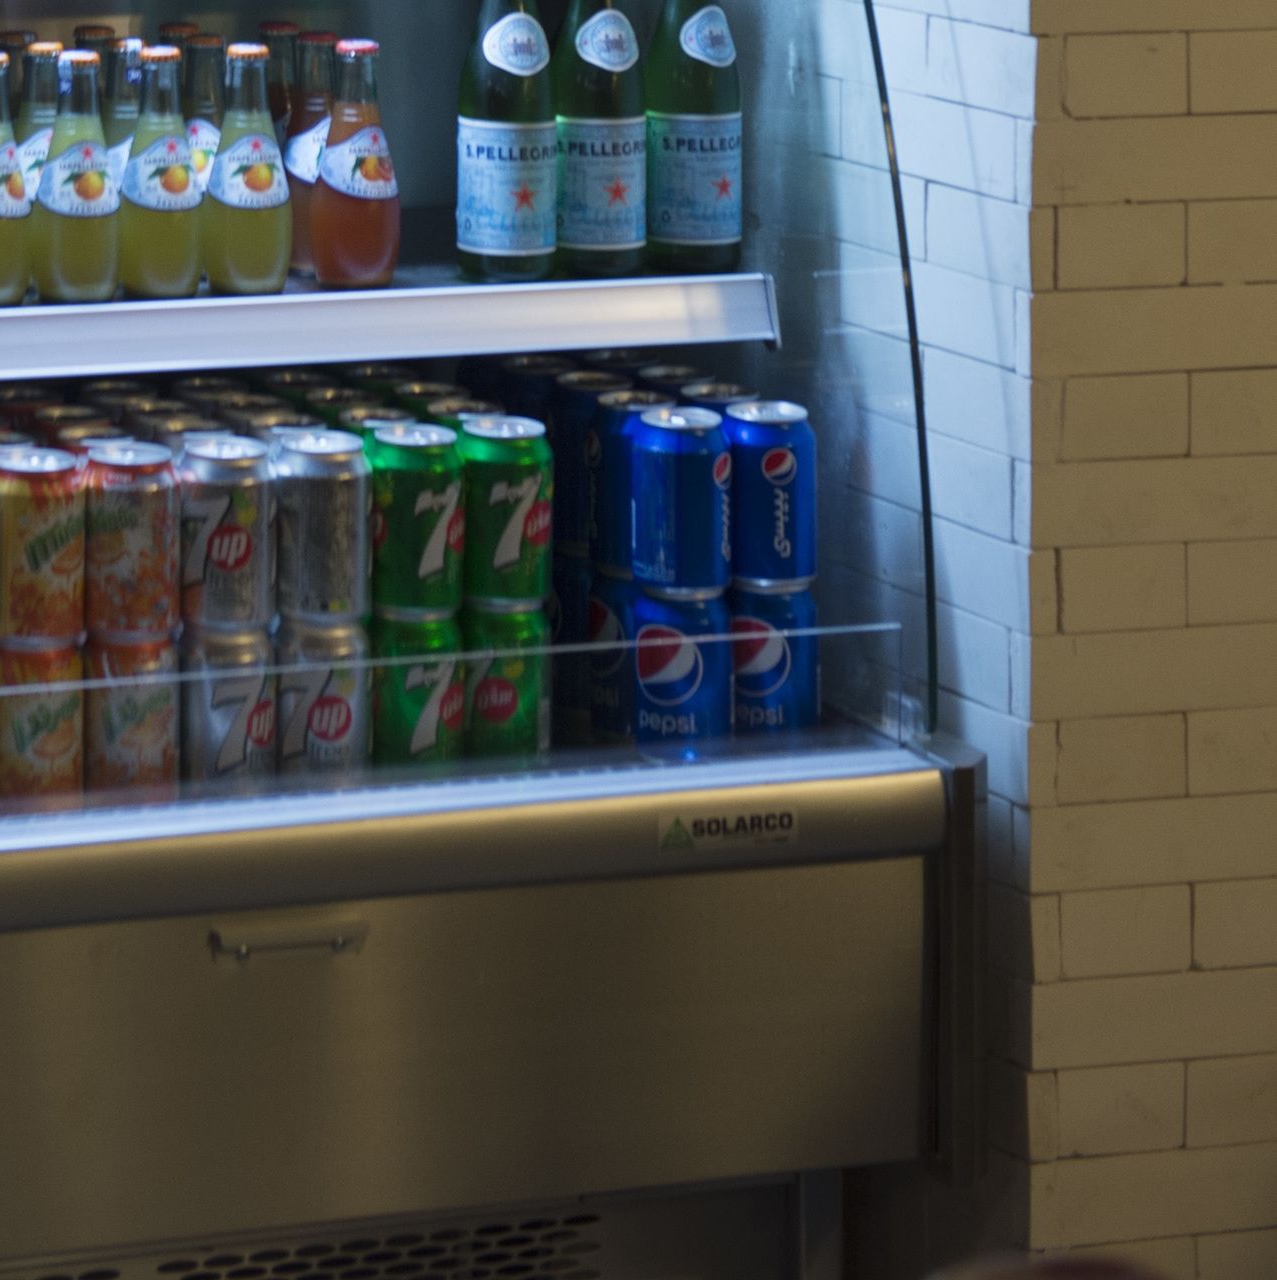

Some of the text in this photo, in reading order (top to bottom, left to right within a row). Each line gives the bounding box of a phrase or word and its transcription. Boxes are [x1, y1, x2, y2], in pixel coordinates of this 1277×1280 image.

[639, 709, 696, 735] pepsi
[738, 703, 784, 725] epsi
[692, 812, 793, 838] SOLARCO
